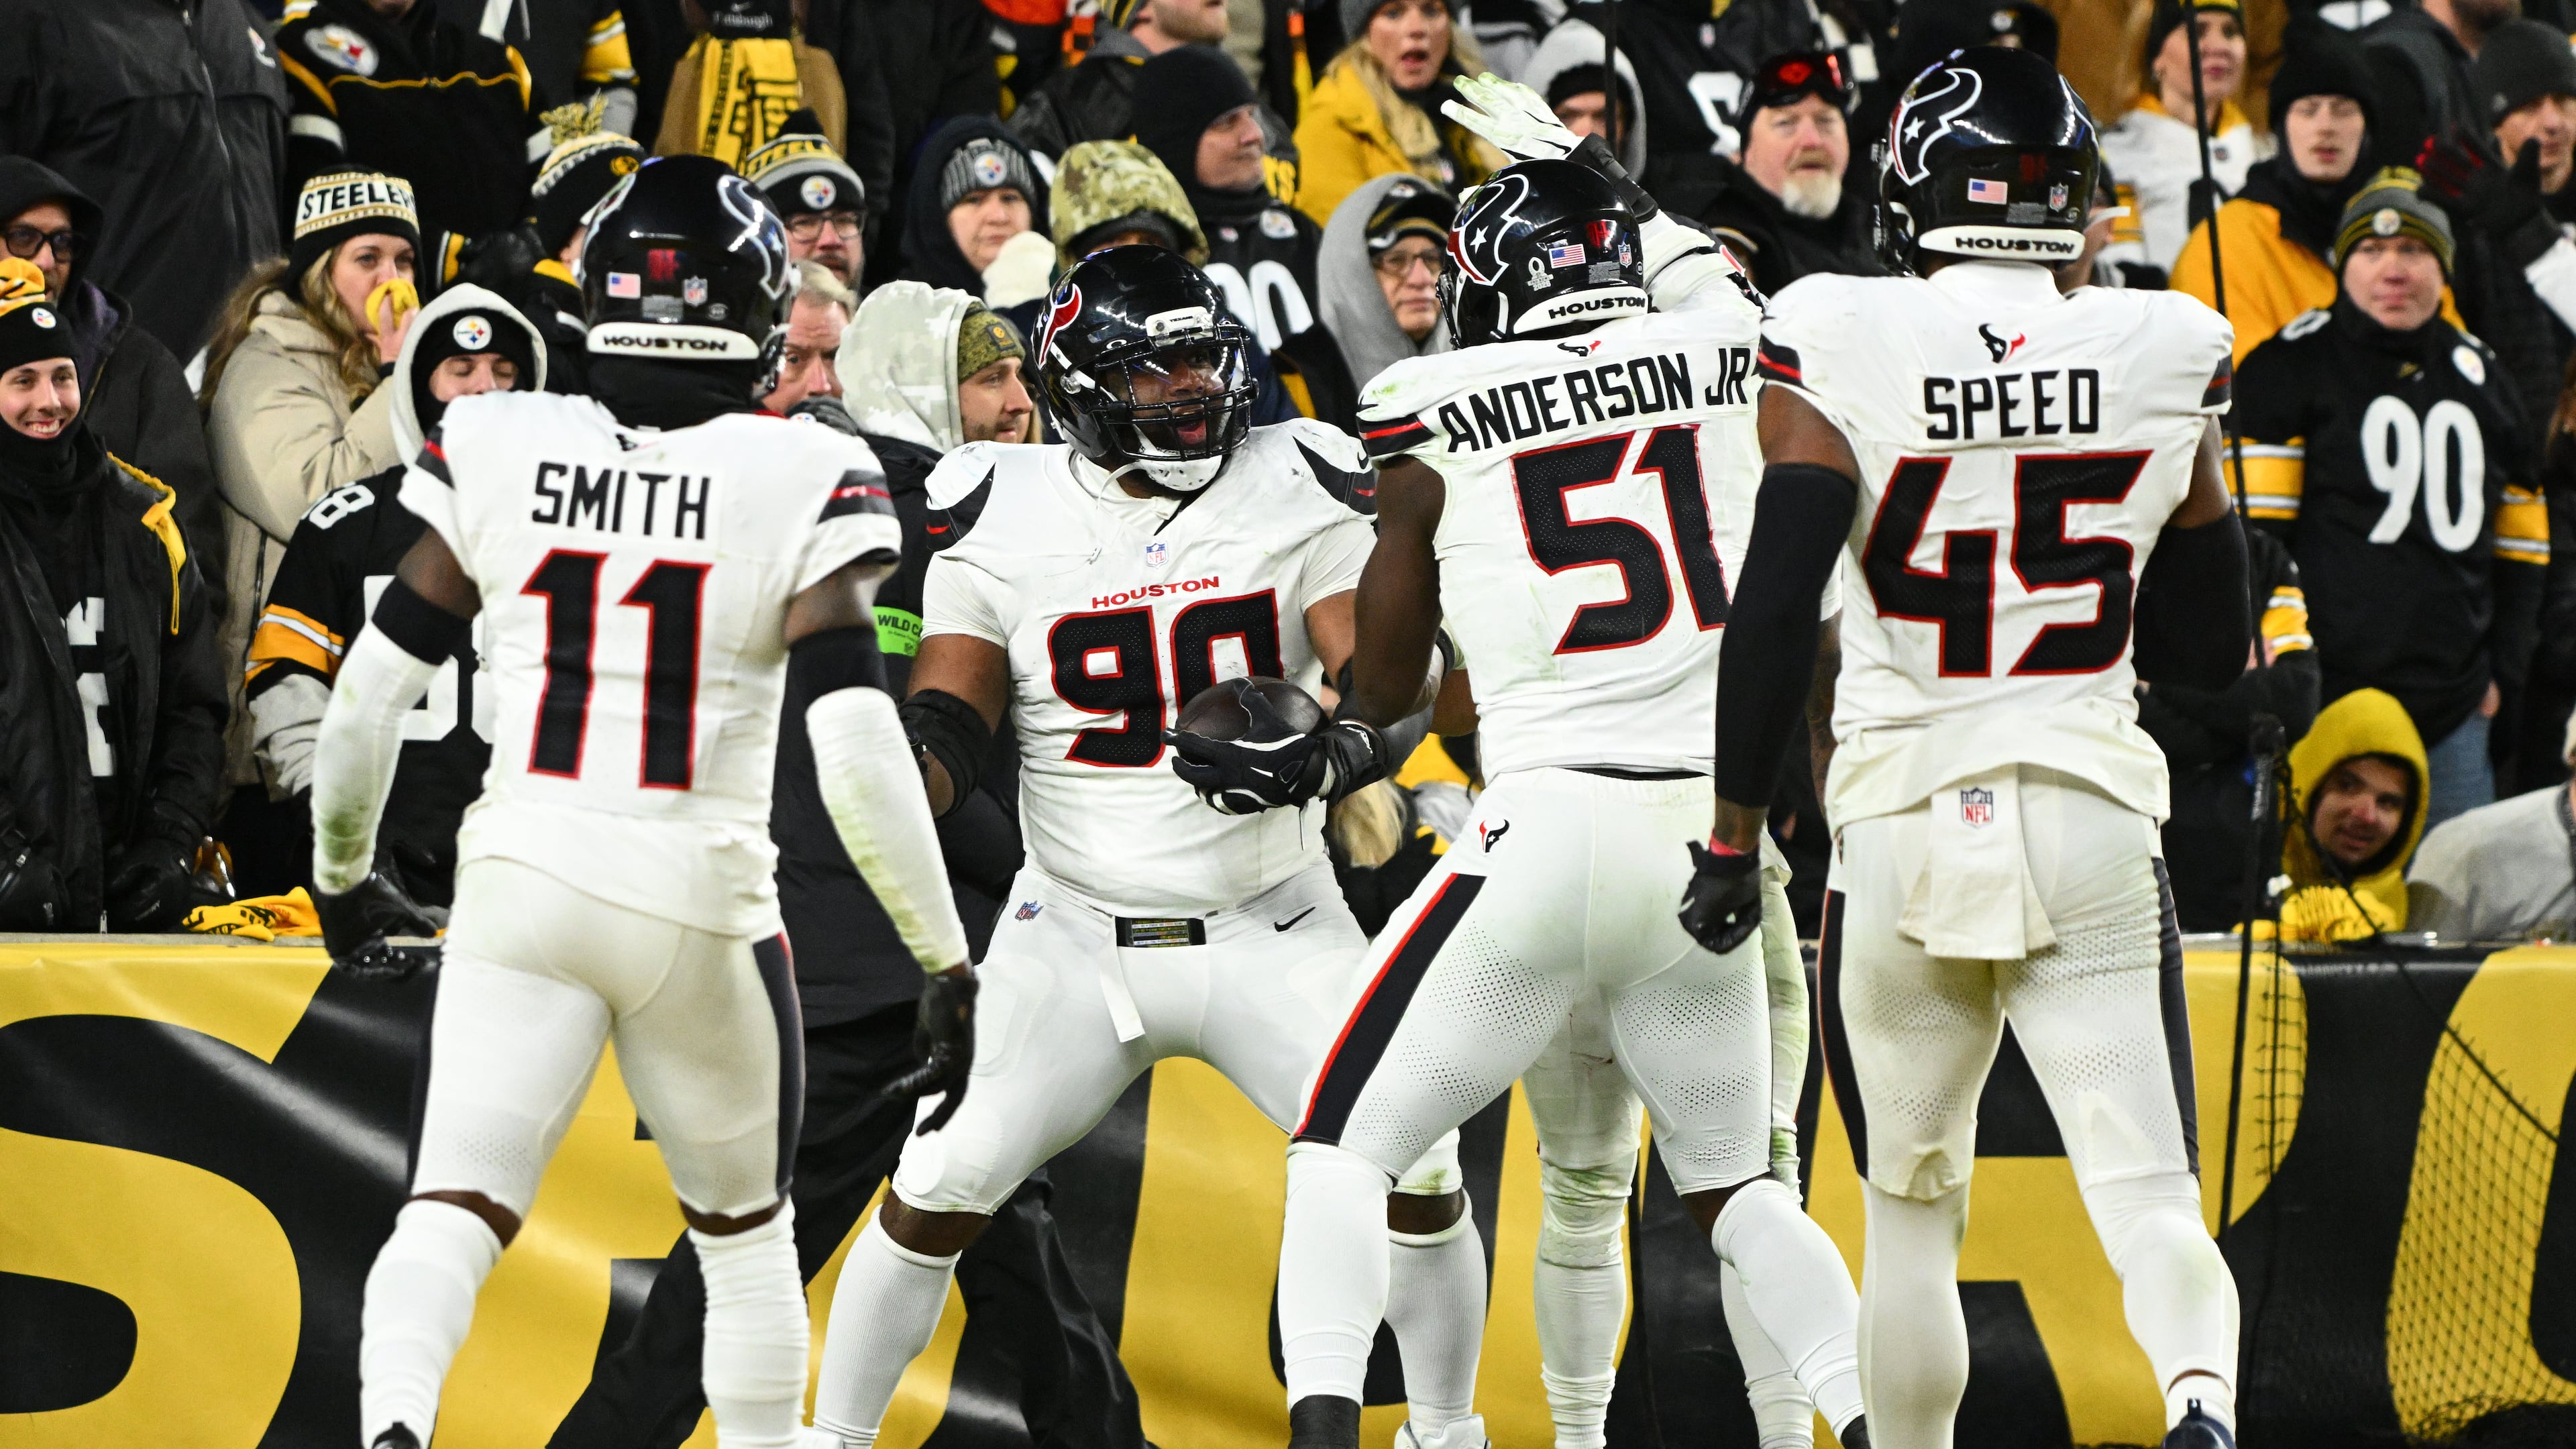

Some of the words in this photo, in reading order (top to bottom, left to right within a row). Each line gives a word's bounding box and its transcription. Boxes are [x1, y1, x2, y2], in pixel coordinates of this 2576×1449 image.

[1955, 237, 2074, 254] HOUSTON
[604, 336, 728, 352] HOUSTON
[1548, 297, 1646, 319] HOUSTON
[1438, 353, 1693, 453] ANDERSON
[1705, 347, 1751, 406] JR
[1924, 369, 2100, 440] SPEED
[532, 462, 711, 540] SMITH
[2361, 394, 2485, 552] 90
[1510, 423, 1733, 655] 51
[1862, 449, 2154, 678] 45
[878, 614, 910, 632] WILD
[1092, 576, 1220, 608] HOUSTON
[519, 547, 714, 791] 11
[1047, 588, 1284, 767] 90
[1965, 805, 1990, 824] NFL
